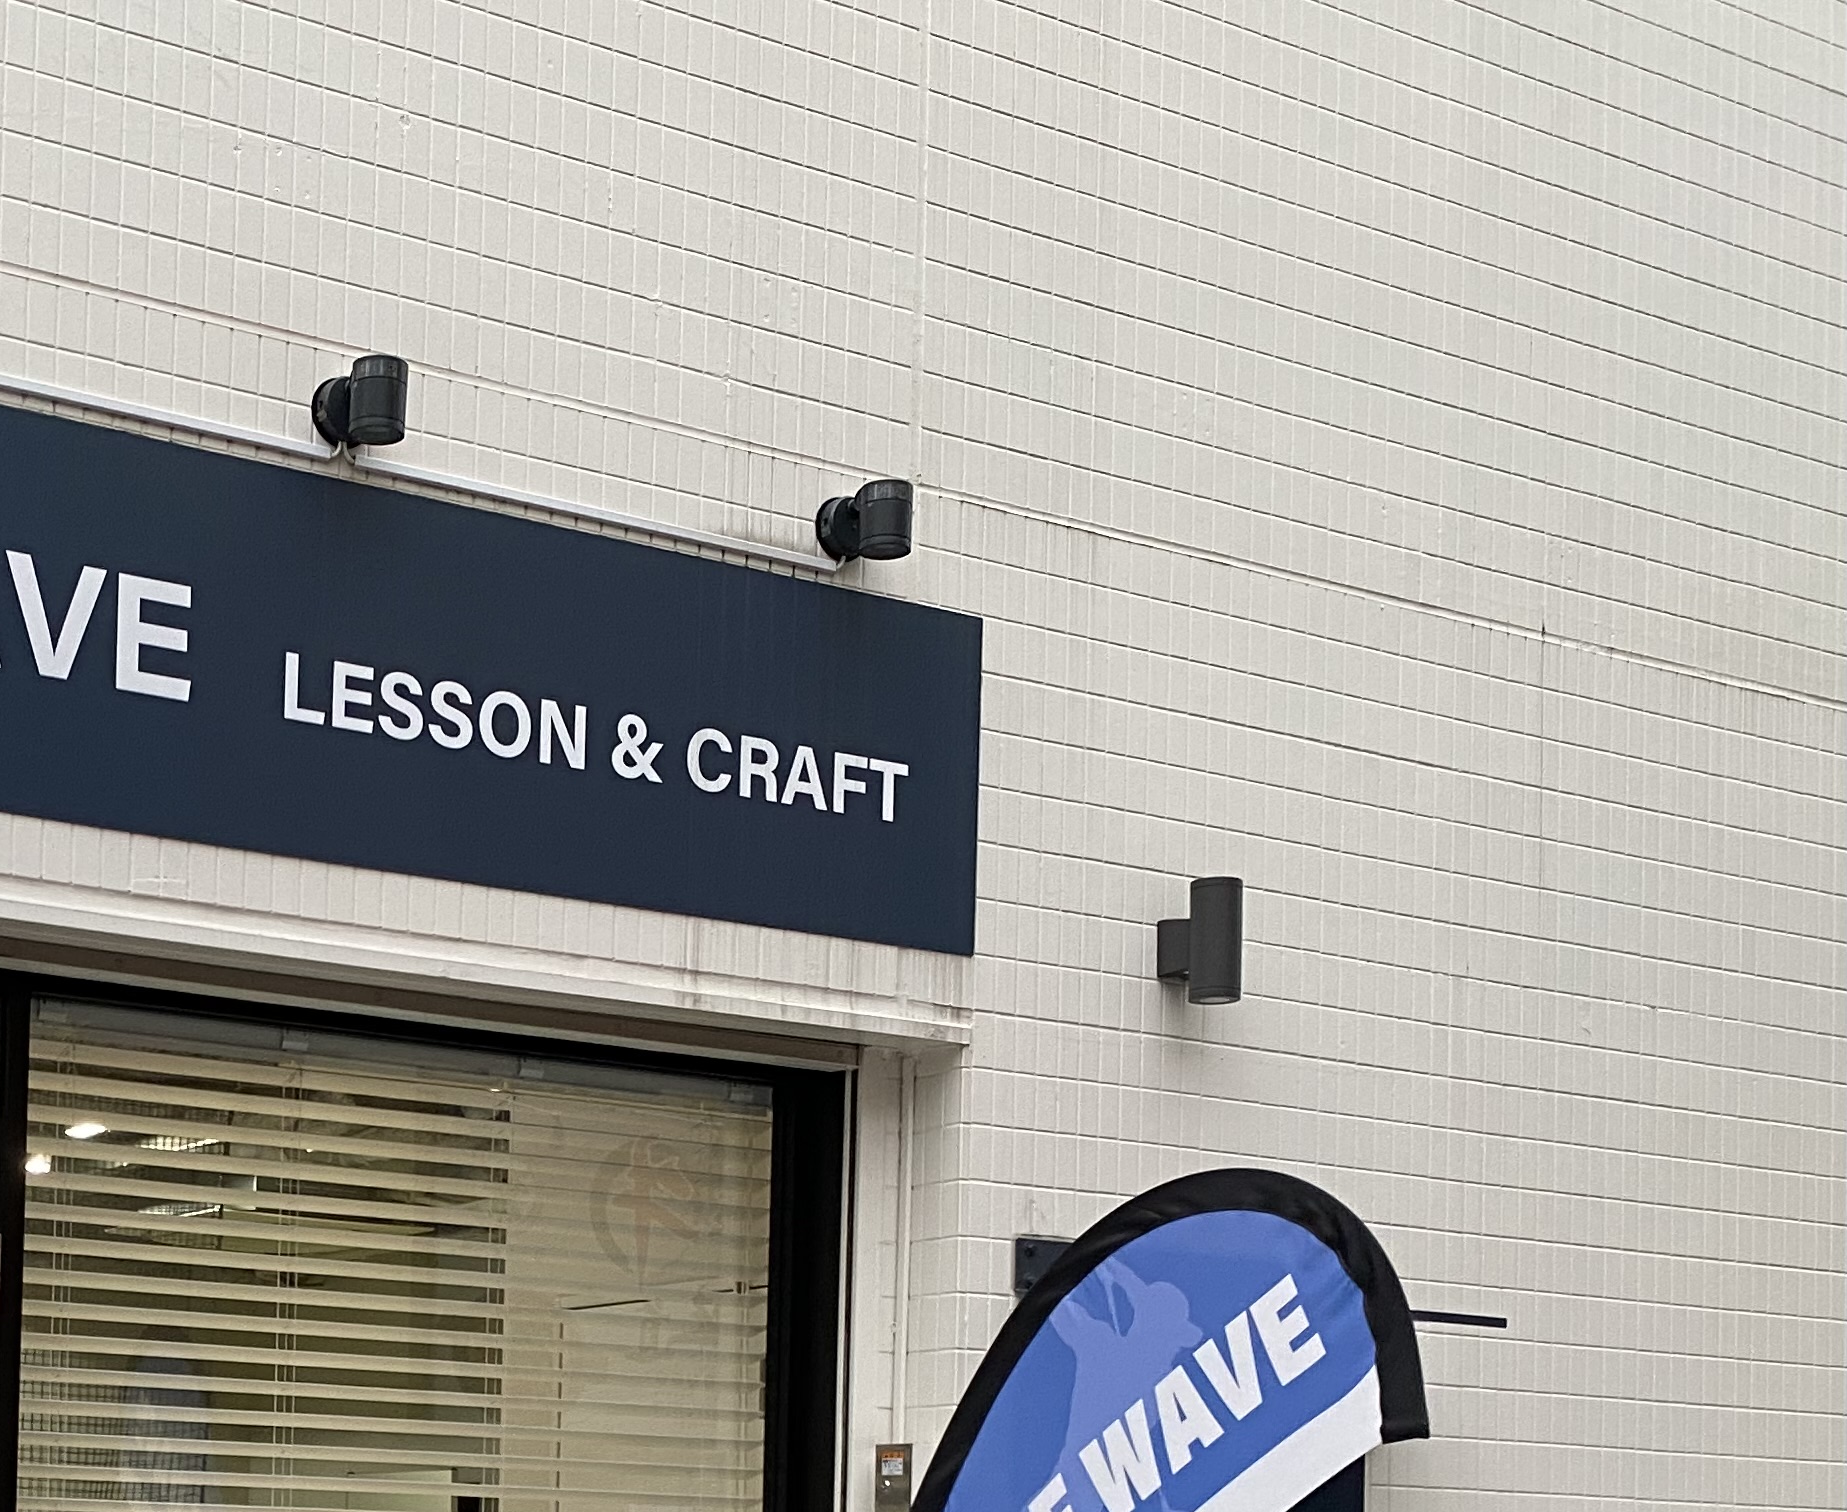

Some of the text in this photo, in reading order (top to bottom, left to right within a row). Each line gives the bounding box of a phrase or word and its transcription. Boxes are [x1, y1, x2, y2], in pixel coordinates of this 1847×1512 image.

[283, 652, 910, 823] LESSON & CRAFT
